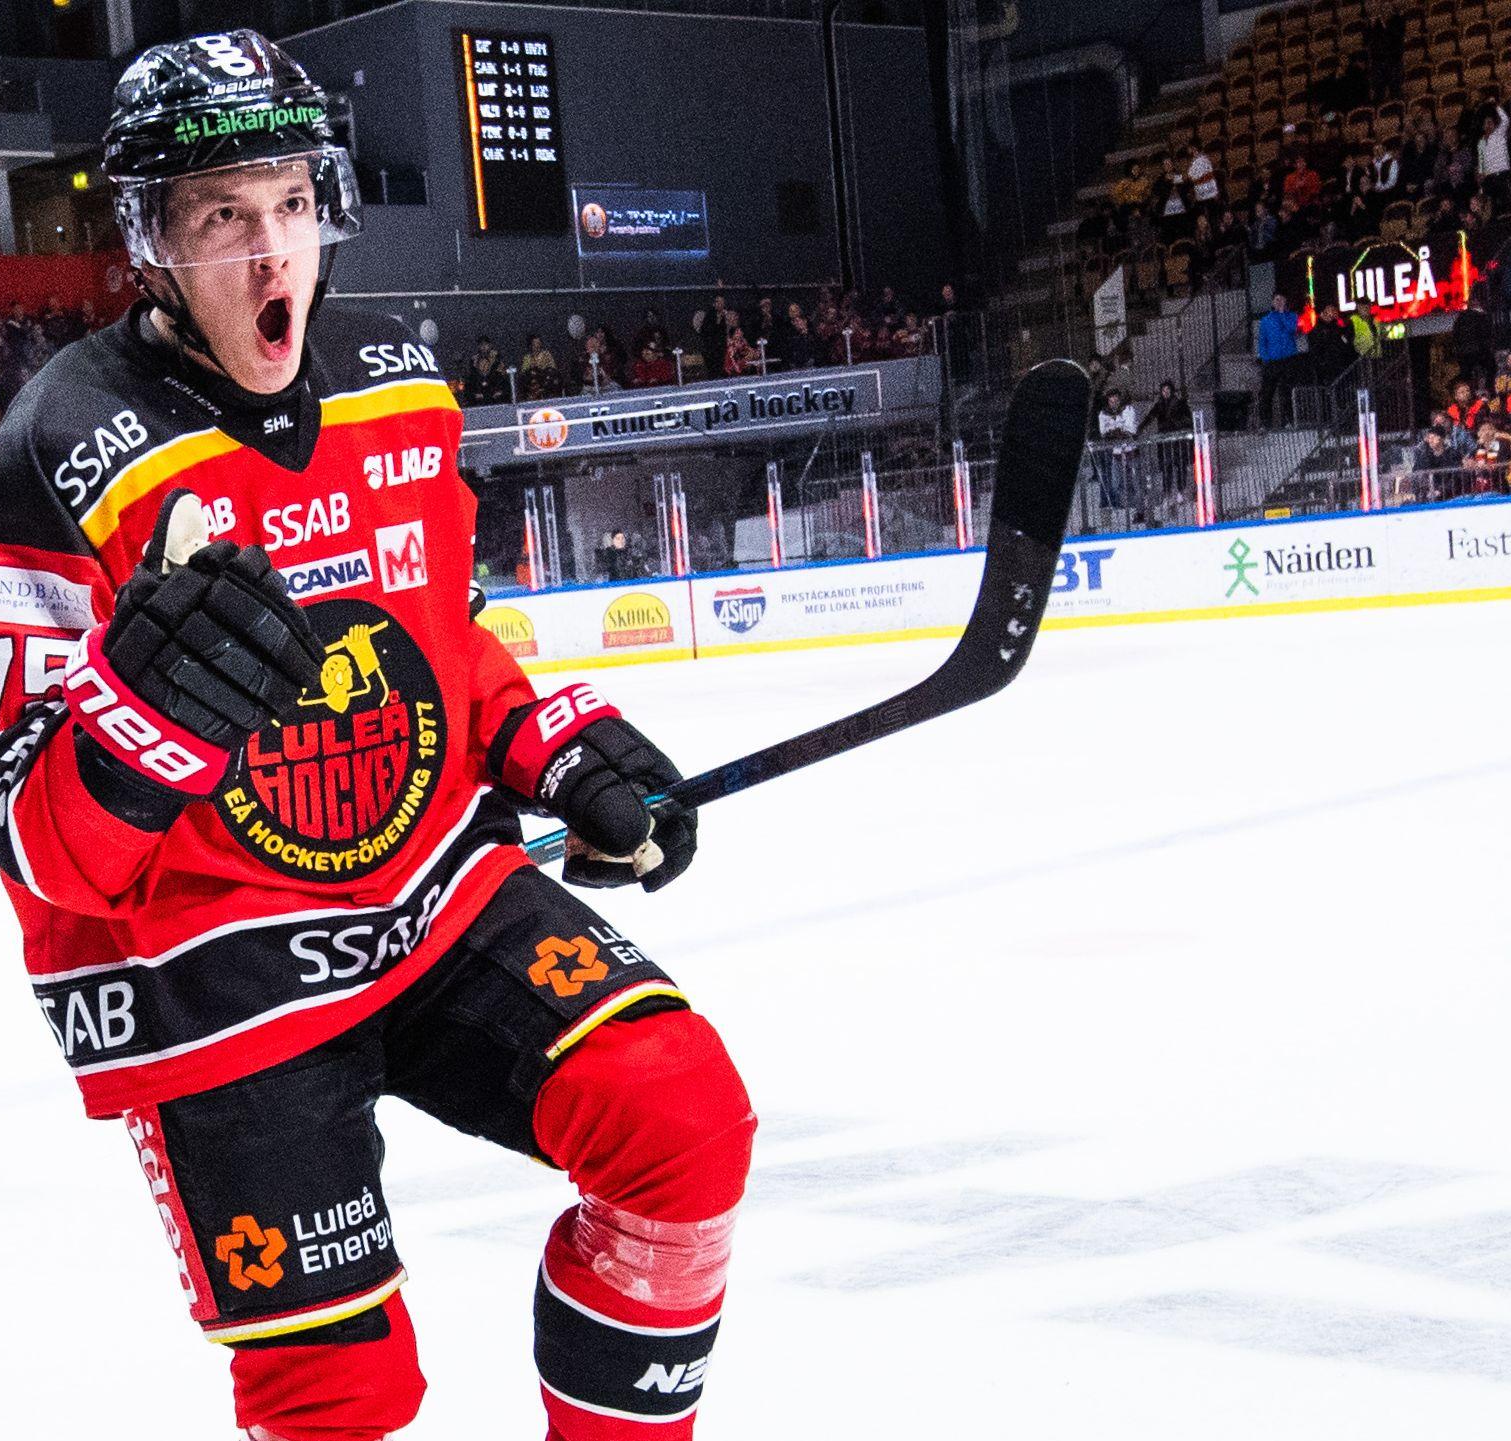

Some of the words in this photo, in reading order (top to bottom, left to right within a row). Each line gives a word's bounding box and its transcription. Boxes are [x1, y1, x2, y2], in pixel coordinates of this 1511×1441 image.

[264, 415, 294, 434] SHL
[704, 391, 739, 430] på
[748, 384, 855, 421] hockey
[55, 410, 148, 507] SSAB
[262, 492, 351, 552] SSAB
[285, 558, 370, 595] CANIA
[1263, 541, 1376, 577] Nåiden
[608, 606, 665, 628] SKOOGS
[804, 603, 827, 615] MED
[248, 690, 410, 767] LULEÅ
[247, 768, 432, 872] HOCKEYFÖRENING
[416, 700, 437, 759] 1977
[250, 740, 409, 841] HOCKEY
[292, 1186, 377, 1242] Luleå
